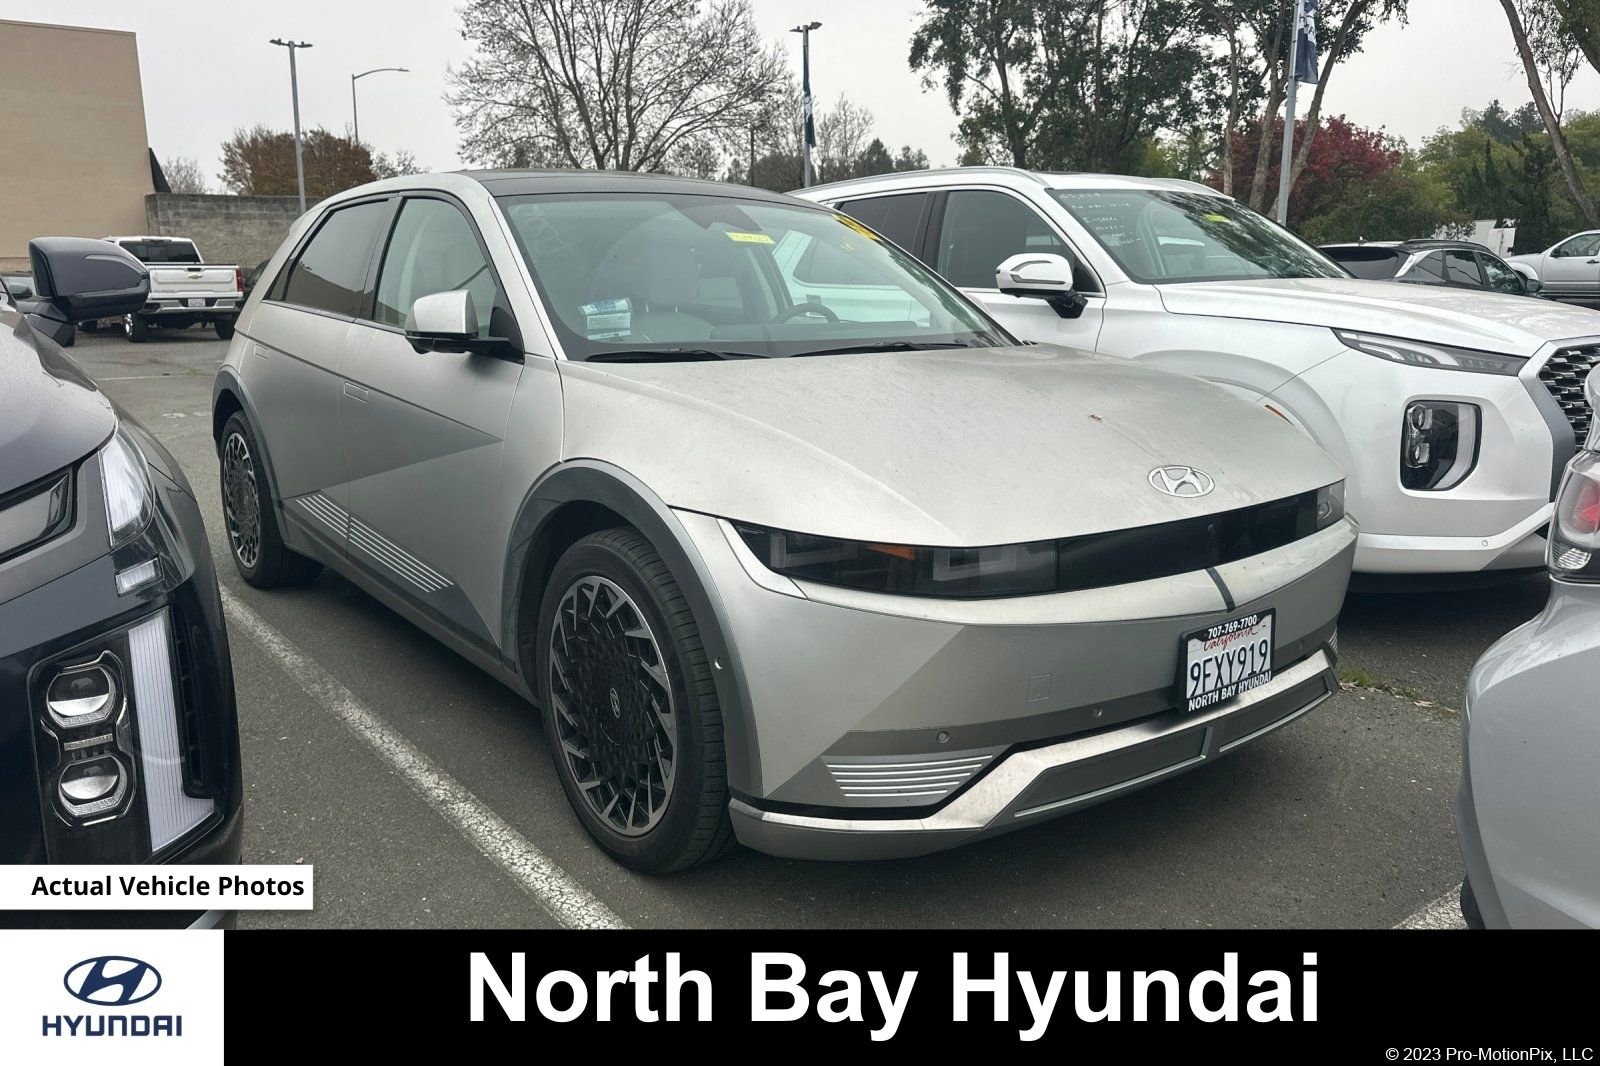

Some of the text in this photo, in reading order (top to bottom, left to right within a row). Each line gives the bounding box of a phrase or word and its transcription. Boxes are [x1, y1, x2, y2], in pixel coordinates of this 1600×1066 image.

[1204, 628, 1258, 651] California
[1208, 615, 1257, 639] 707-769-7700
[1190, 639, 1268, 698] 9FXY919
[1188, 671, 1272, 712] NORTH BAY HYUNDAI
